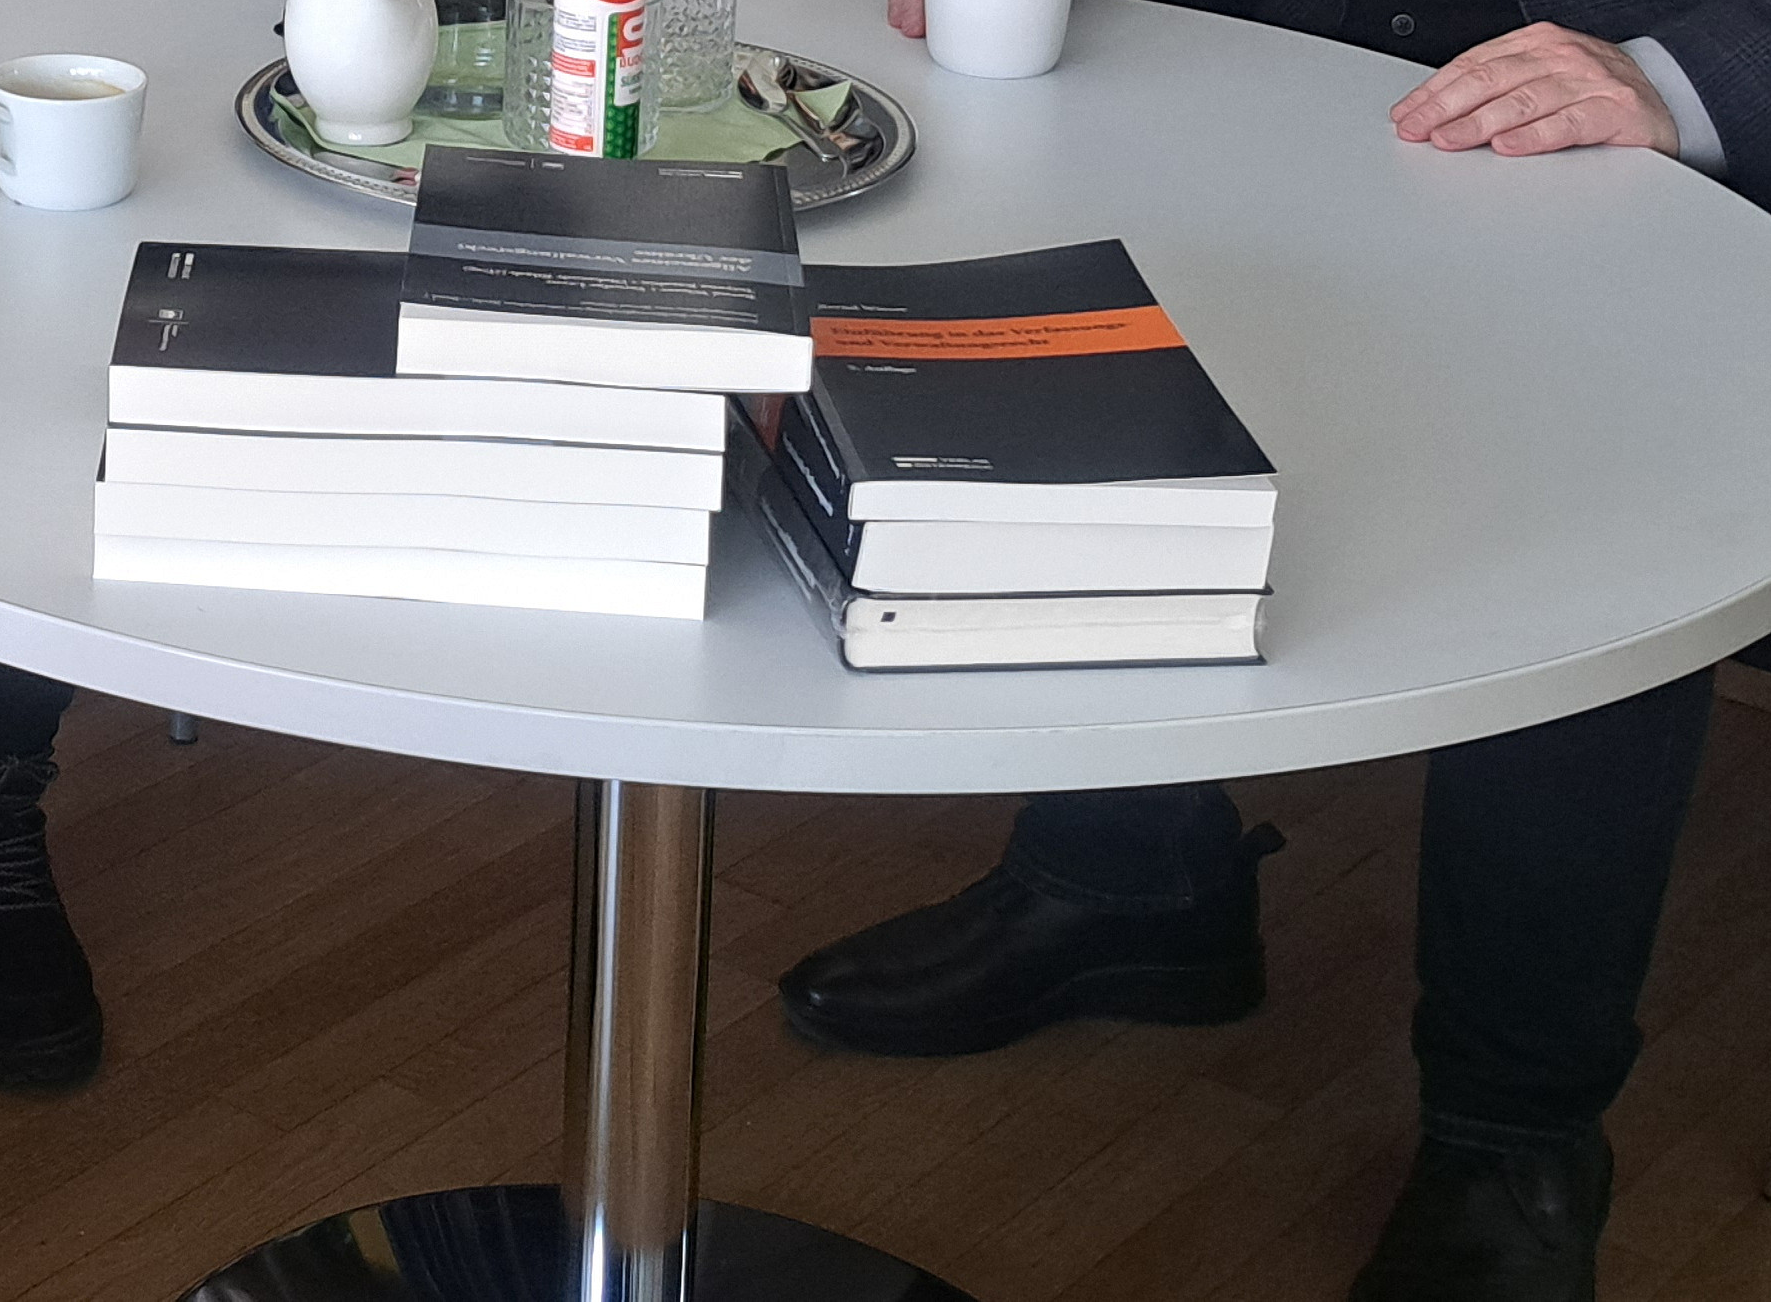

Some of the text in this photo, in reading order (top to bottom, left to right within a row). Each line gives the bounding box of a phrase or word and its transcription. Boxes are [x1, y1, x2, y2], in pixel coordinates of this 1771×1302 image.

[830, 325, 943, 339] Einführung
[948, 329, 966, 338] in
[971, 329, 1005, 337] das
[834, 337, 1050, 349] und Verwaltungsrecht
